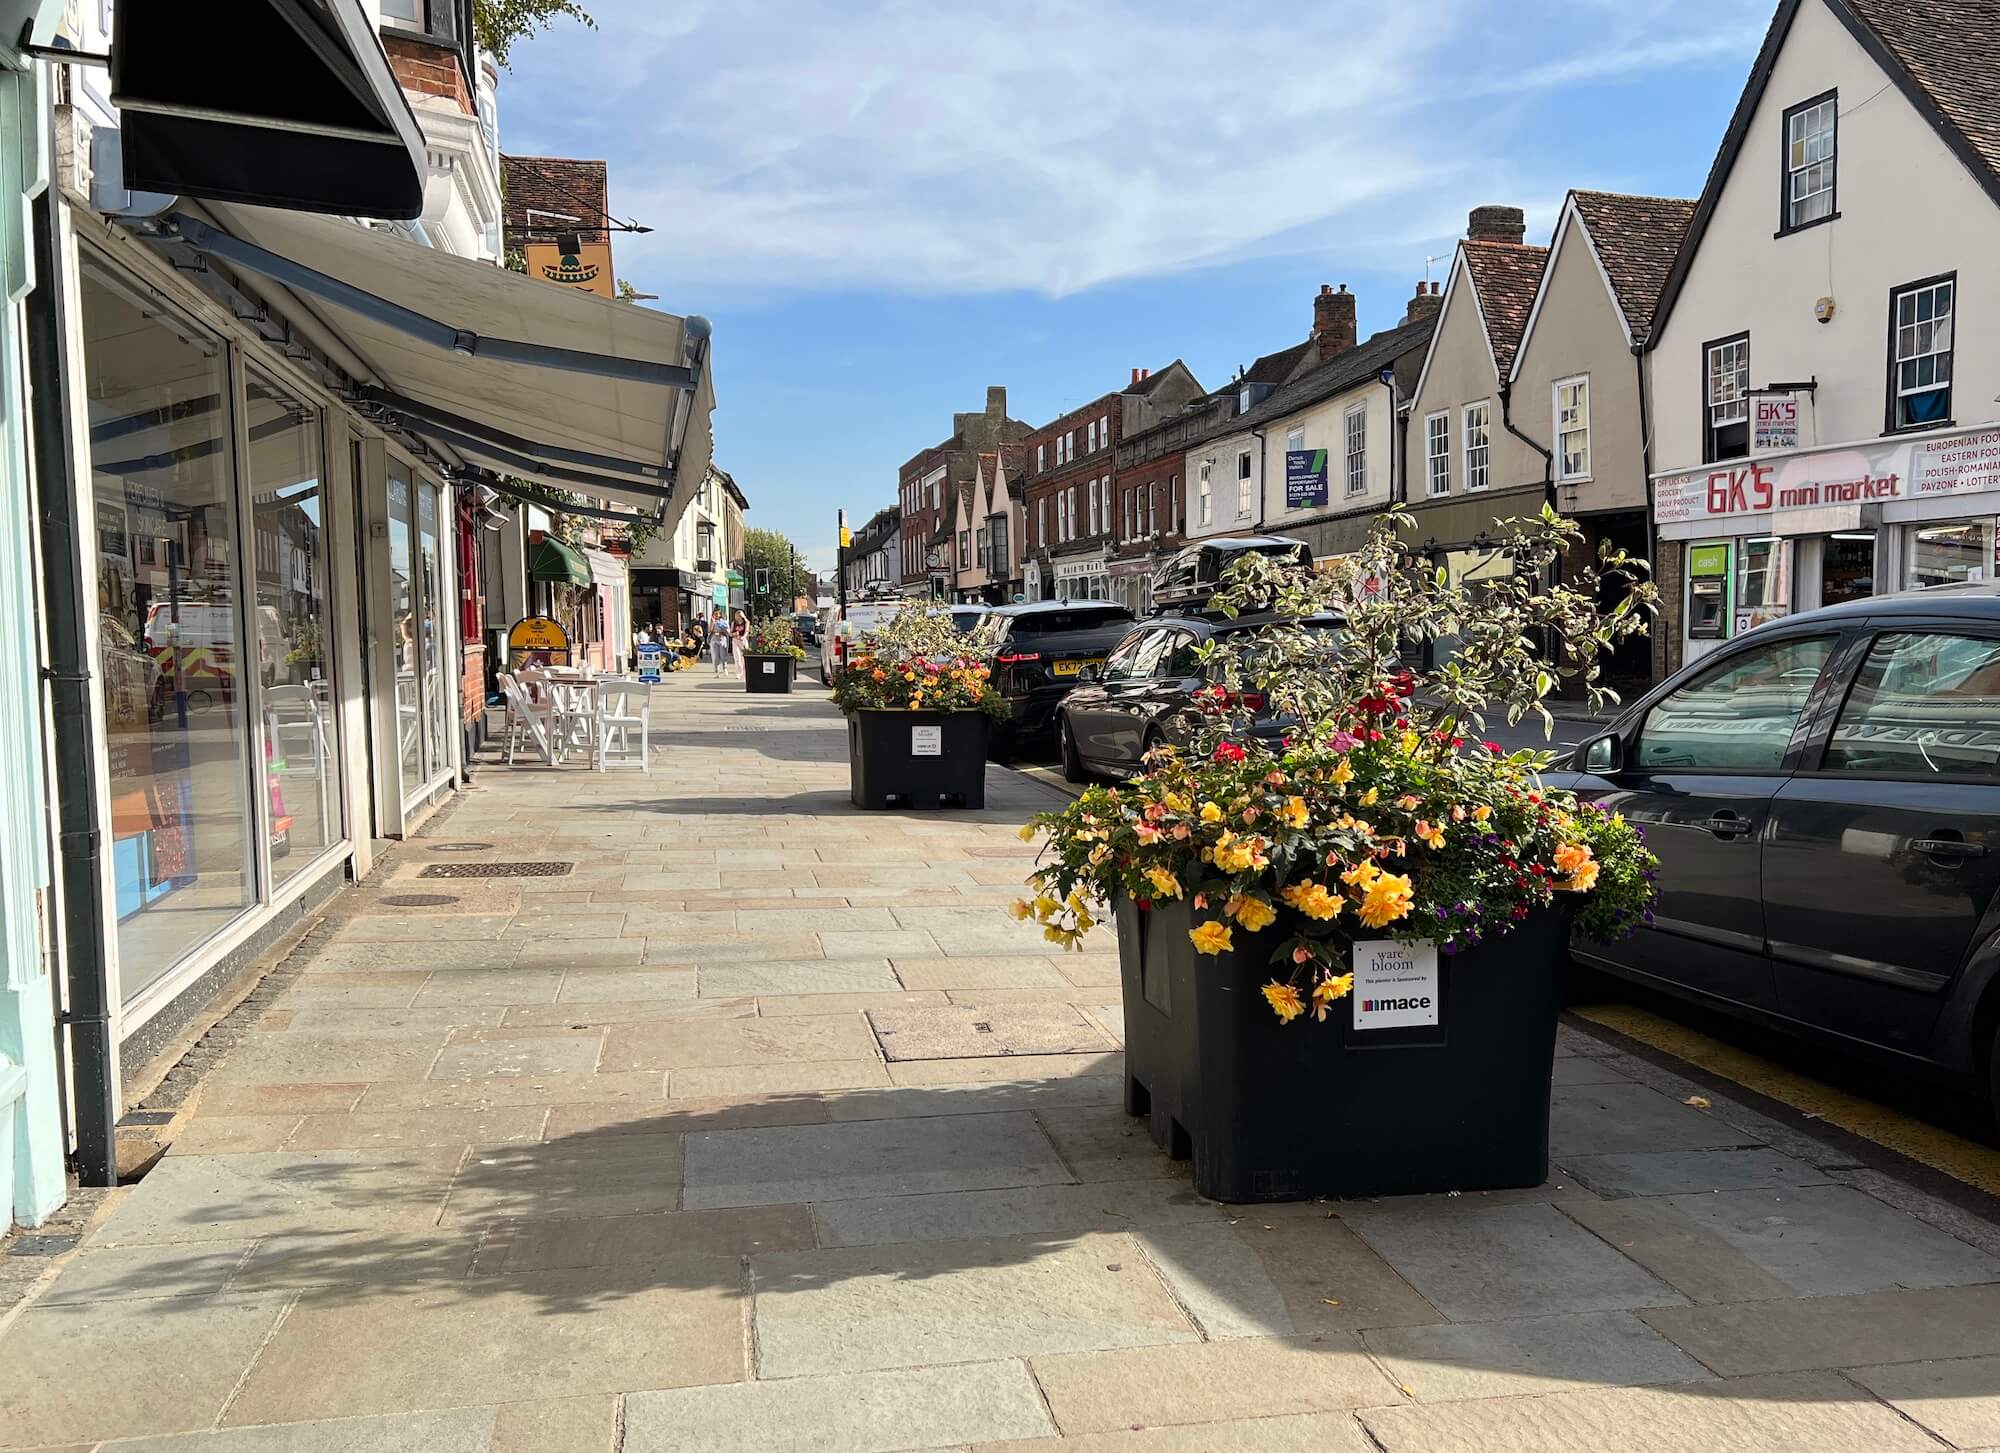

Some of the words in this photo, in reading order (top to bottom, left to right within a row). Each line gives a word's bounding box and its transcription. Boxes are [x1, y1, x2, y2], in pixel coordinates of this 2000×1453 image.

[1758, 402, 1796, 420] GK'S
[1926, 436, 1979, 452] EUROPENIAN
[1981, 433, 2000, 444] FOO
[1941, 450, 1978, 463] EASTERN
[1980, 447, 2000, 458] FOO
[1925, 461, 2000, 478] POLISH-ROMANIA
[1707, 463, 1774, 513] GK'S
[1780, 482, 1819, 507] mini
[1824, 473, 1901, 503] market
[1921, 479, 1958, 491] PAYZONE
[1697, 554, 1718, 568] cash
[1371, 958, 1414, 972] bloom
[1380, 996, 1431, 1011] mace
